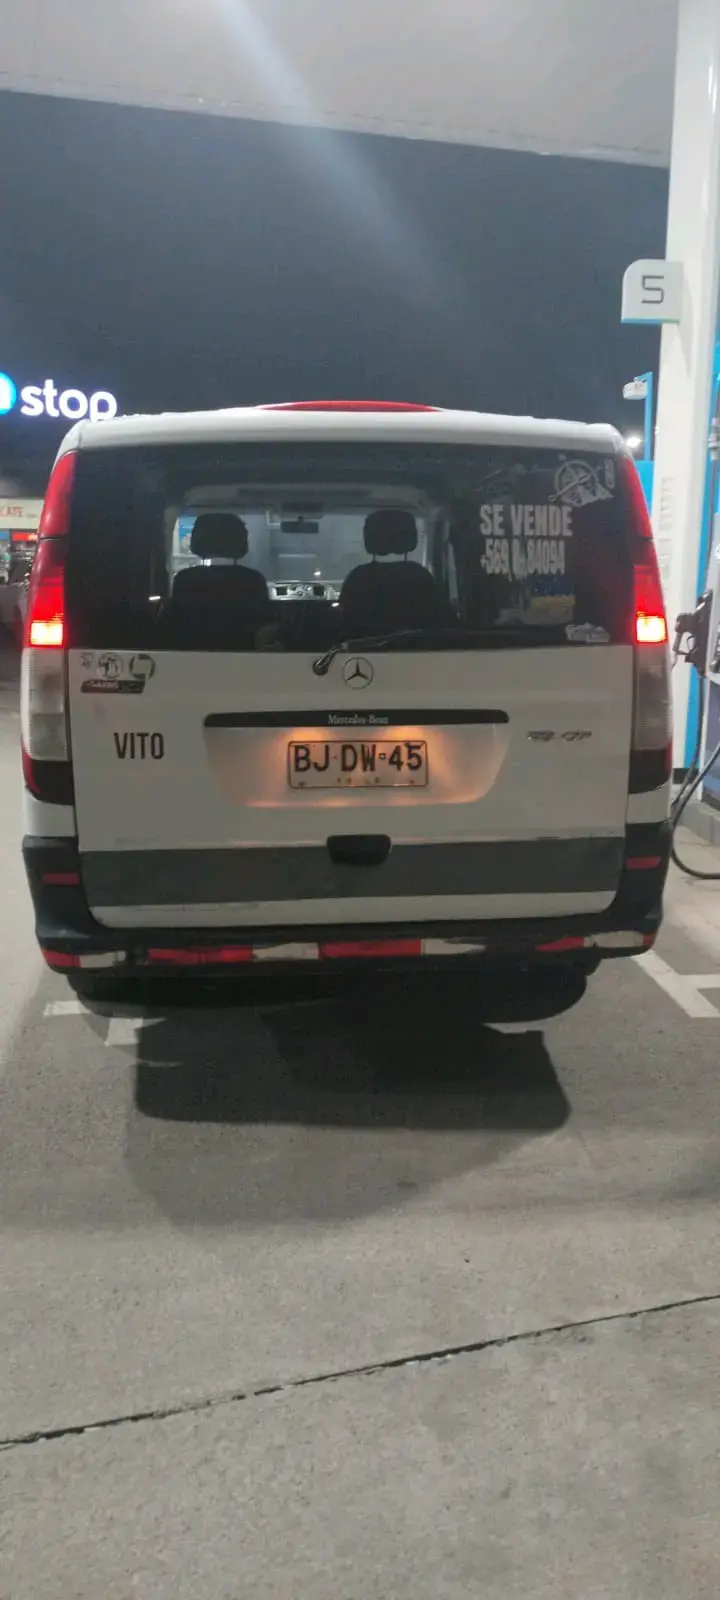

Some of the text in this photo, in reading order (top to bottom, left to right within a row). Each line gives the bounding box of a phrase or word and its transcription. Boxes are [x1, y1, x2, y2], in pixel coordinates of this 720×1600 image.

[641, 275, 665, 304] 5
[18, 378, 118, 420] stop
[480, 503, 573, 537] SE VENDE
[113, 732, 165, 759] VITO
